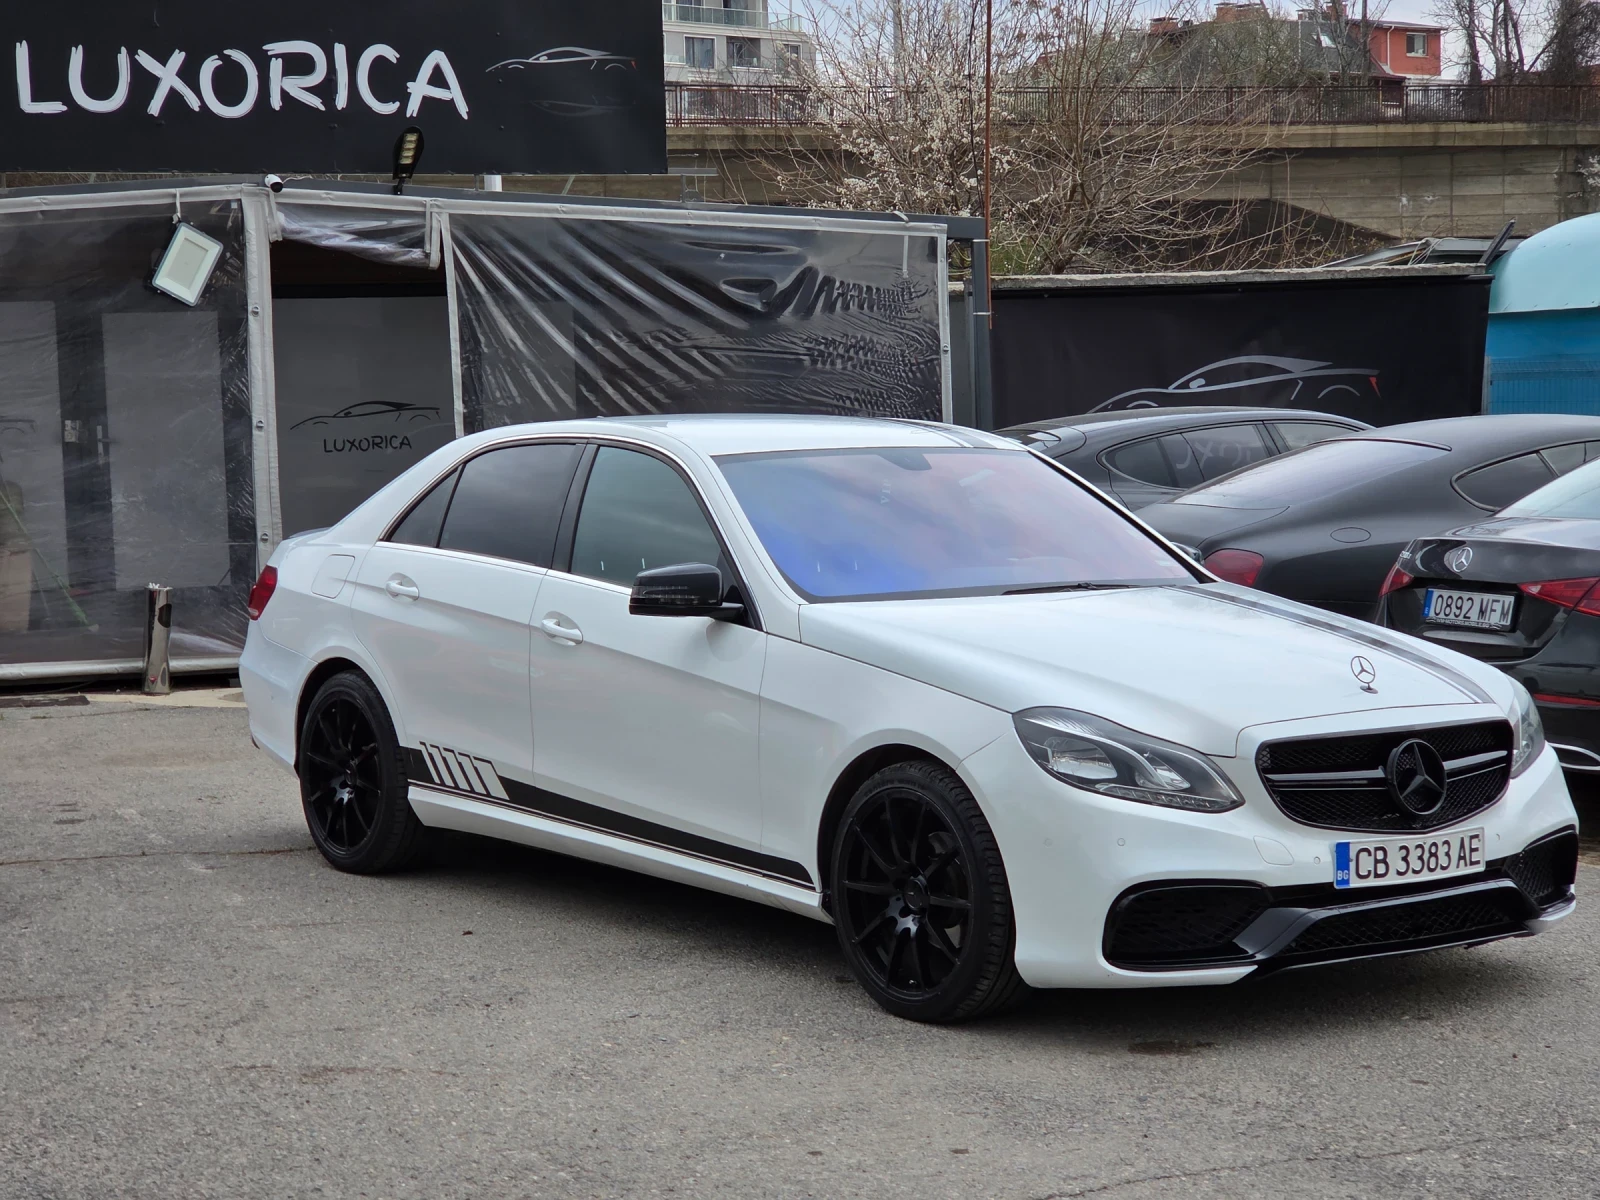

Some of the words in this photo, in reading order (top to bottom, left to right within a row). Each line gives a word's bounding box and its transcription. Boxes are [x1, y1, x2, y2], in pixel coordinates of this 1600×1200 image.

[15, 39, 469, 120] LUXORICA
[323, 434, 412, 453] LUXORICA
[1433, 594, 1475, 620] 0892
[1477, 597, 1512, 626] MFM
[1355, 845, 1390, 880] CB
[1396, 839, 1451, 877] 3383
[1456, 833, 1481, 869] AE
[1337, 869, 1349, 881] BG
